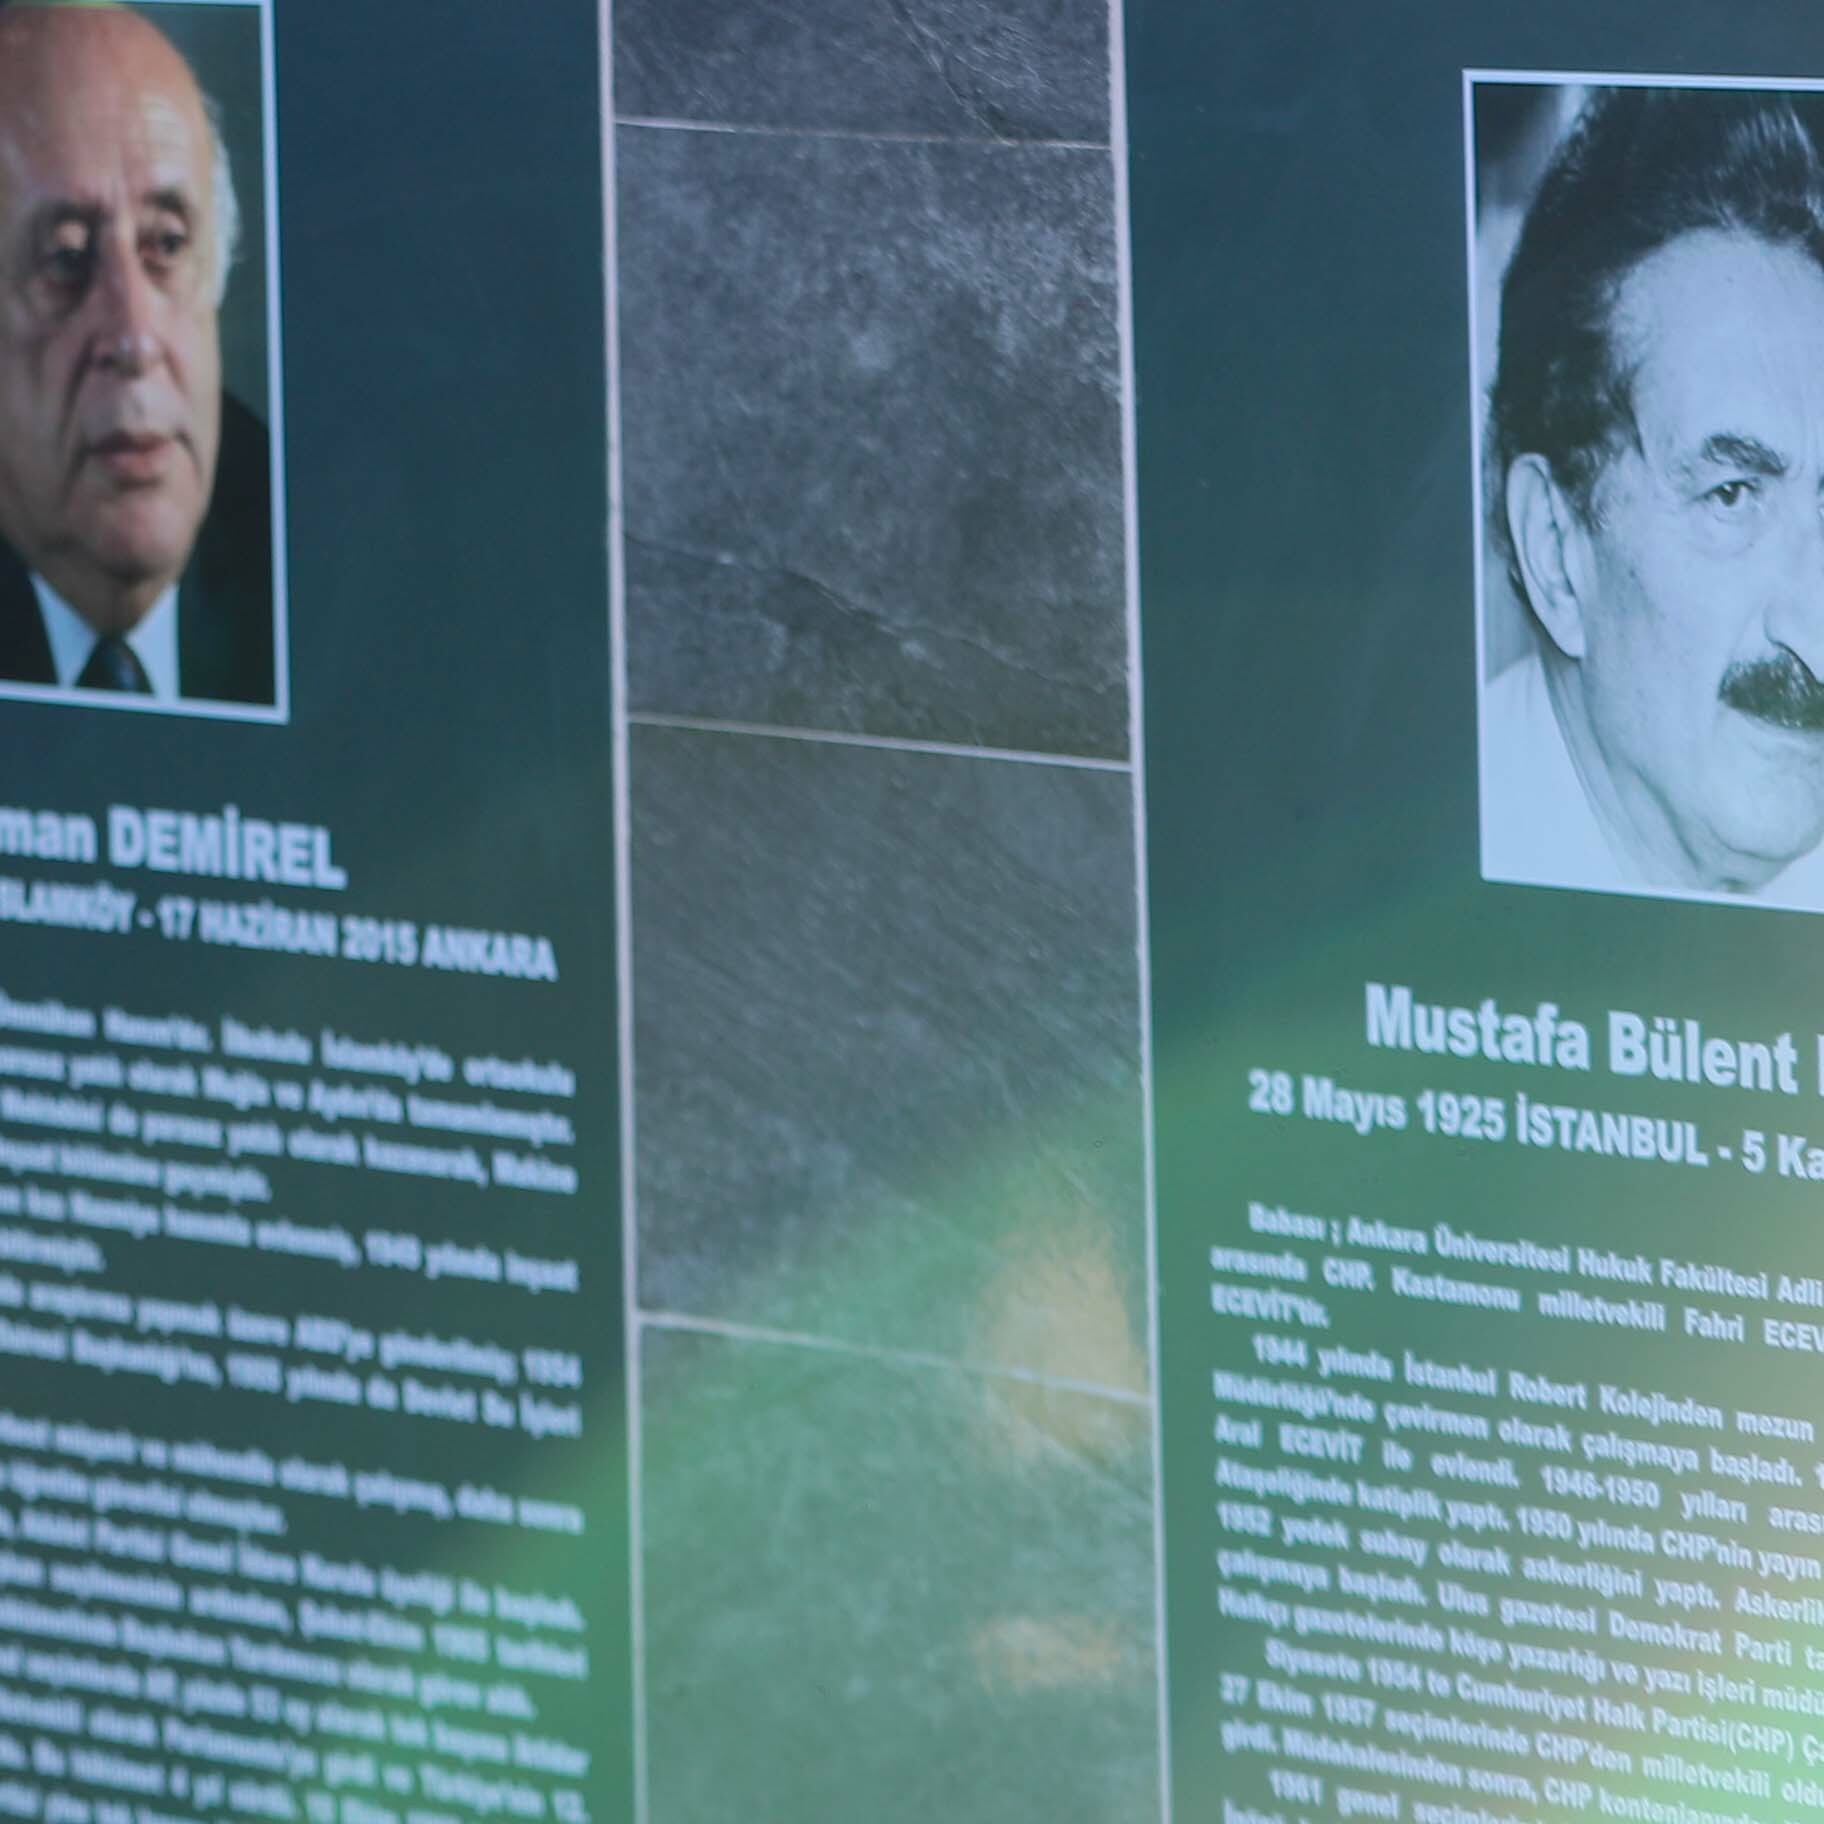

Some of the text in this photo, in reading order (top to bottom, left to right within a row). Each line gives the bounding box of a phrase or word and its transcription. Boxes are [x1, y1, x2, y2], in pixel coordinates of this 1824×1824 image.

[108, 805, 347, 889] DEMİREL
[156, 895, 197, 939] 17
[198, 900, 337, 957] HAZİRAN
[342, 915, 418, 965] 2015
[422, 926, 557, 982] ANKARA
[1366, 984, 1589, 1069] Mustafa
[1609, 1011, 1798, 1094] Bülent
[1250, 1069, 1293, 1113] 28
[1303, 1076, 1406, 1134] Mayıs
[1417, 1090, 1505, 1140] 1925
[1516, 1094, 1708, 1165] İSTANBUL
[1742, 1130, 1766, 1172] 5
[1347, 1217, 1427, 1253] Ankara
[1434, 1224, 1570, 1273] Üniversitesi
[1578, 1248, 1652, 1284] Hukuk
[1660, 1259, 1768, 1299] Fakültesi
[1392, 1267, 1520, 1310] Kastamonu
[1538, 1290, 1665, 1331] milletvekili
[1684, 1307, 1744, 1342] Fahri
[1253, 1334, 1307, 1366] 1944
[1405, 1351, 1496, 1395] İstanbul
[1509, 1371, 1586, 1409] Robert
[1600, 1385, 1723, 1429] Kolejinden
[1736, 1412, 1814, 1442] mezun
[1498, 1416, 1571, 1453] olarak
[1582, 1432, 1699, 1474] çalışmaya
[1710, 1446, 1802, 1486] başladı.
[1541, 1465, 1660, 1508] 1946-1950
[1357, 1480, 1440, 1520] katiplik
[1446, 1501, 1510, 1532] yaptı.
[1516, 1506, 1572, 1539] 1950
[1577, 1519, 1654, 1552] yılında
[1661, 1529, 1752, 1569] CHP'nin
[1758, 1550, 1821, 1582] yayın
[1360, 1529, 1427, 1566] subay
[1438, 1540, 1510, 1575] olarak
[1522, 1556, 1642, 1597] askerliğini
[1655, 1579, 1720, 1611] yaptı.
[1500, 1598, 1596, 1634] gazetesi
[1609, 1610, 1722, 1654] Demokrat
[1735, 1631, 1791, 1666] Parti
[1508, 1643, 1605, 1683] yazarlığı
[1610, 1661, 1638, 1684] ve
[1643, 1666, 1690, 1694] yazı
[1696, 1669, 1755, 1704] işleri
[1456, 1672, 1586, 1722] Cumhuriyet
[1592, 1696, 1645, 1731] Halk
[1652, 1707, 1794, 1762] Partisi(CHP)
[1536, 1731, 1631, 1773] CHP'den
[1642, 1754, 1770, 1797] milletvekili
[1544, 1776, 1592, 1809] CHP
